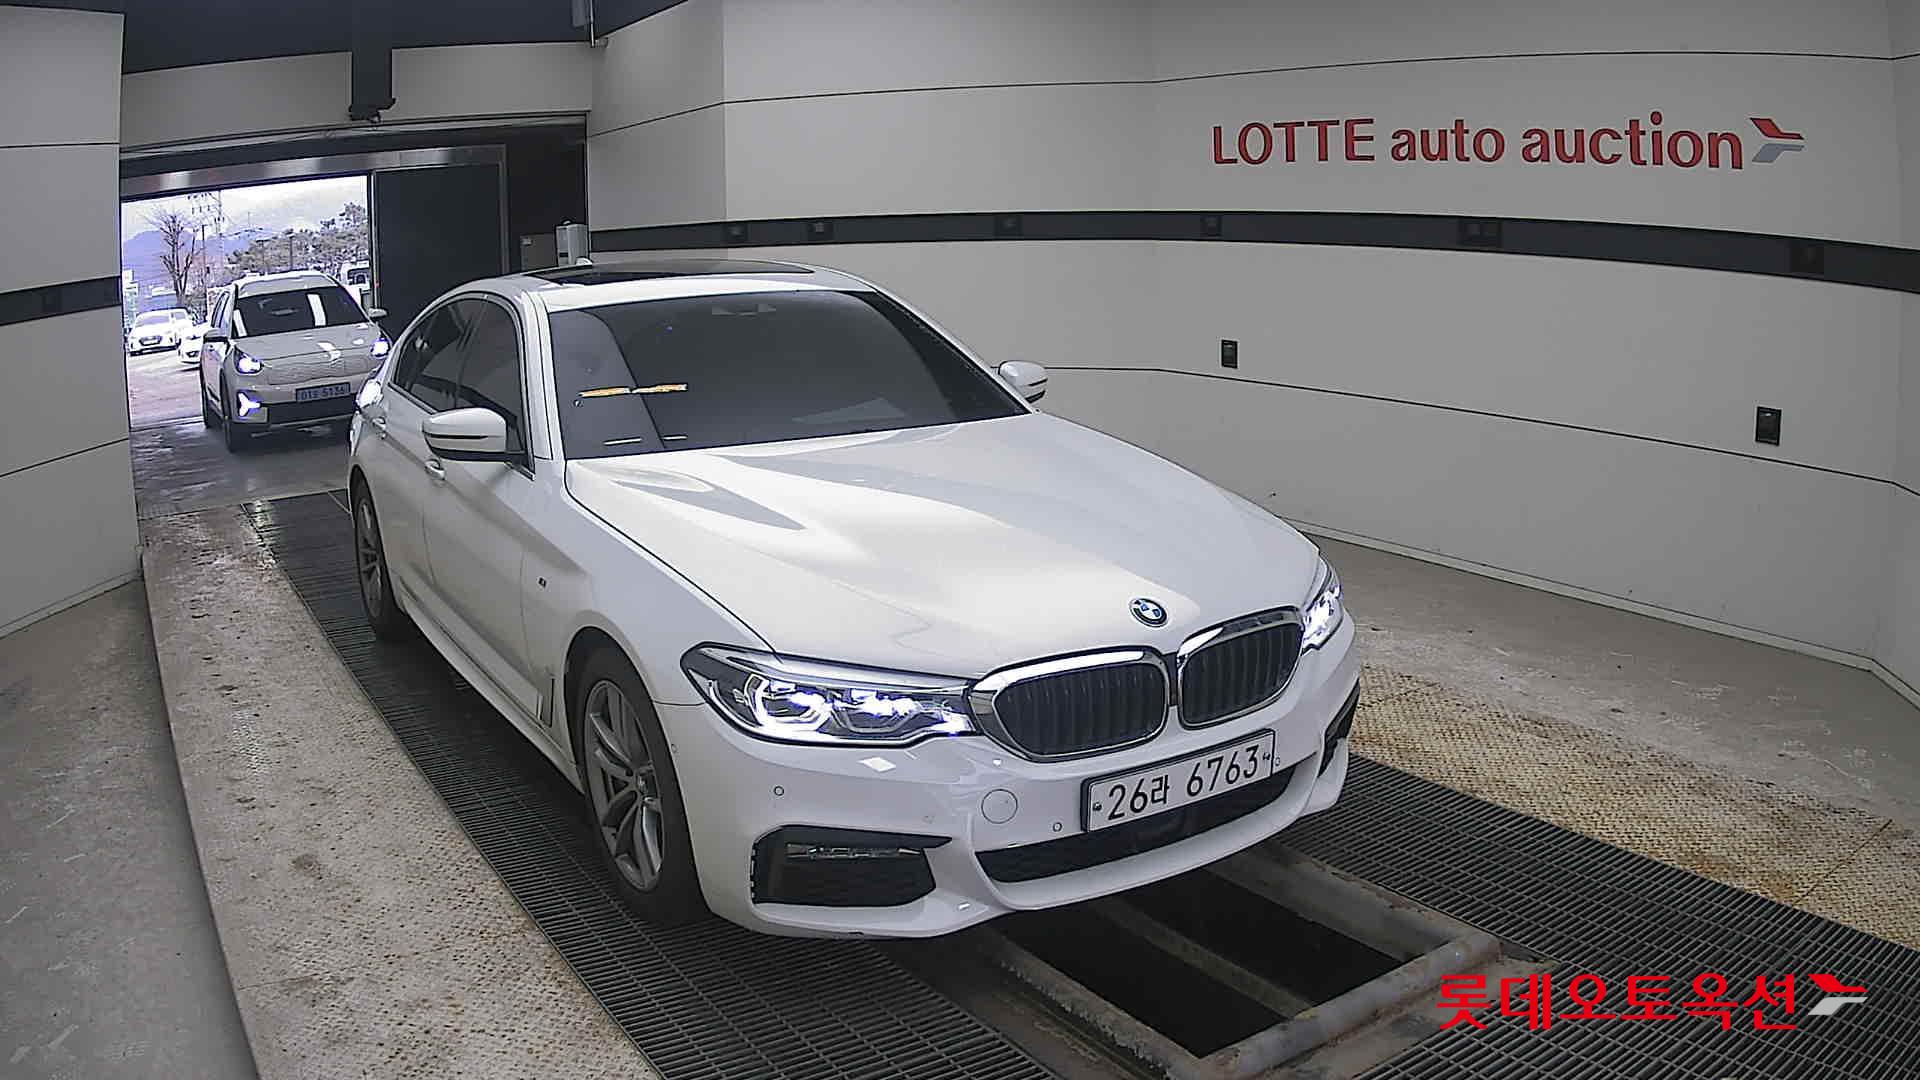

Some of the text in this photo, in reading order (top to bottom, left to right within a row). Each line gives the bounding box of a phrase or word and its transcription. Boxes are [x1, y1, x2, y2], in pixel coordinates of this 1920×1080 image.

[1212, 111, 1744, 170] LOTTE auto auction
[1107, 744, 1260, 821] 26라 6763
